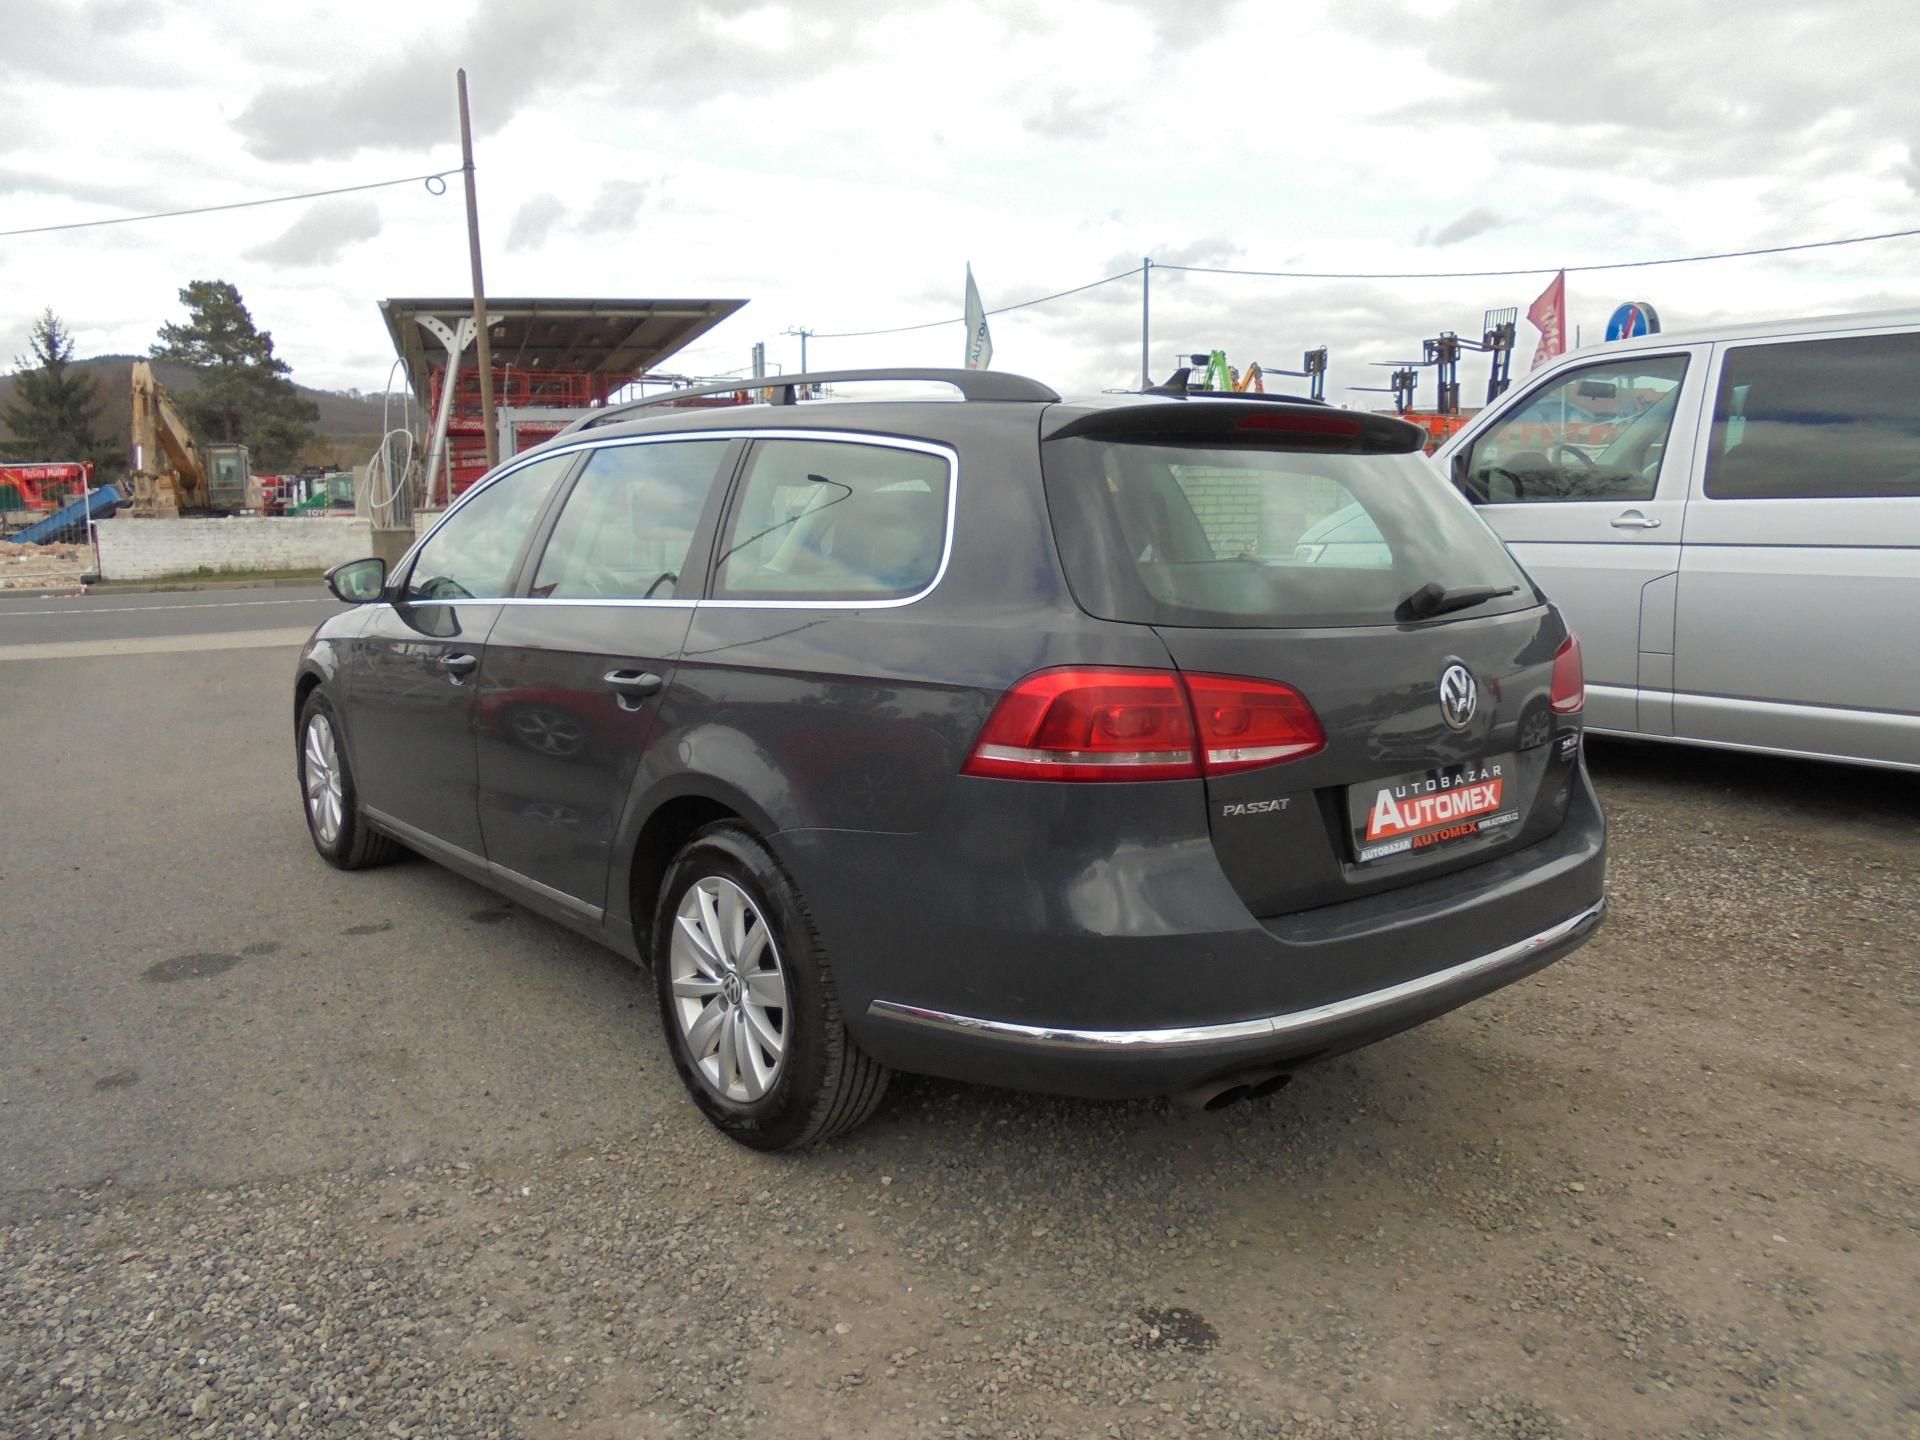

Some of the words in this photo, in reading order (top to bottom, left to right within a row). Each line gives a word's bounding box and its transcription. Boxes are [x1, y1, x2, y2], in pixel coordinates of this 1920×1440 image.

[47, 466, 68, 477] Müller
[1222, 798, 1290, 817] PASSAT
[1371, 783, 1498, 835] AUTOMEX
[1359, 840, 1412, 863] AUTOBAZAR
[1413, 821, 1480, 849] AUTOMEX
